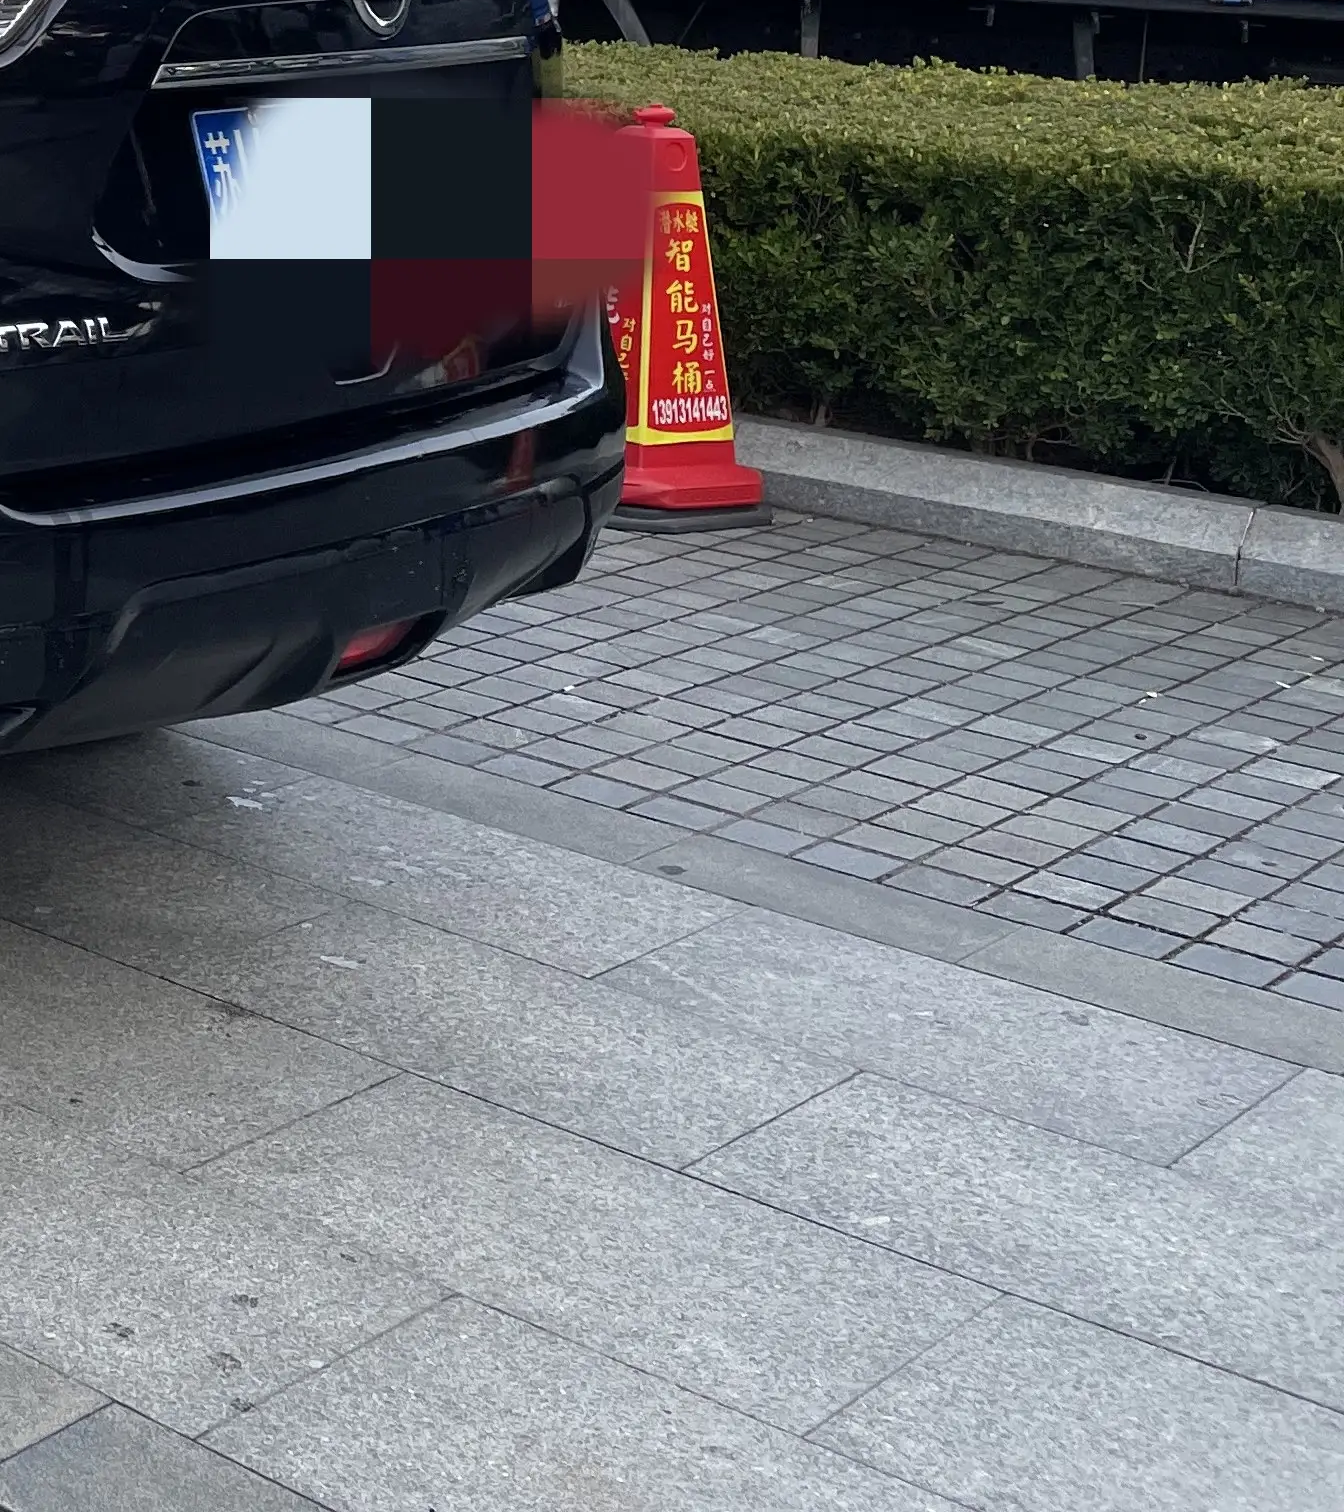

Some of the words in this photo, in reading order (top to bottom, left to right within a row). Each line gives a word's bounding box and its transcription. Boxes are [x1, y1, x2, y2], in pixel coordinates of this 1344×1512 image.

[658, 208, 700, 234] 潜水艇
[665, 240, 703, 394] 智能马桶
[652, 395, 728, 426] 13913141443
